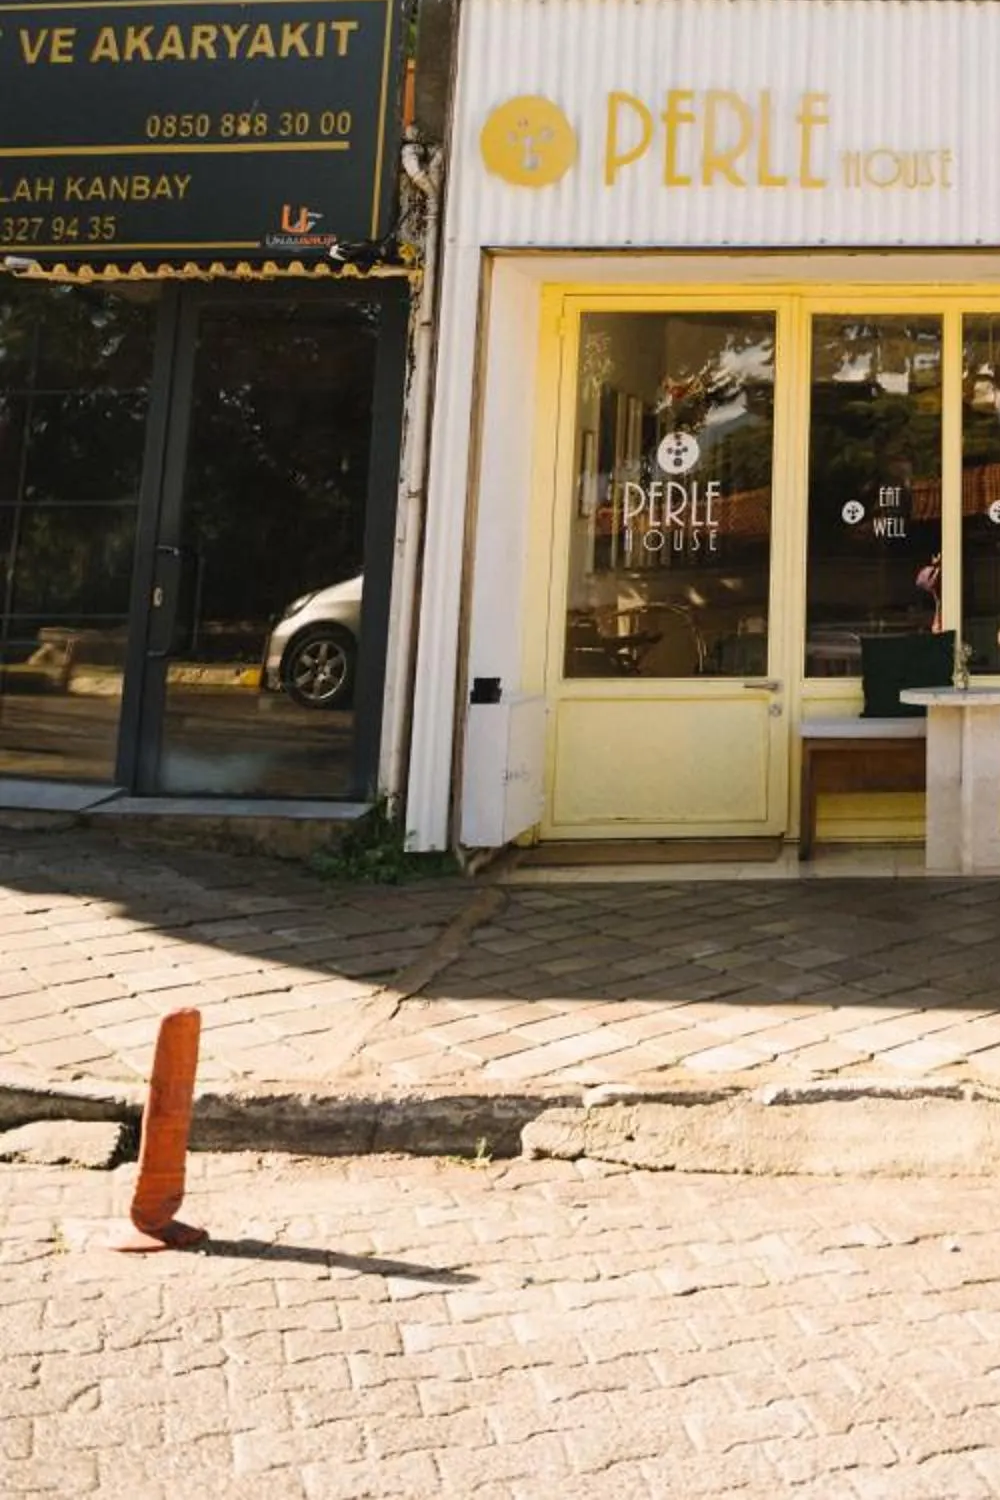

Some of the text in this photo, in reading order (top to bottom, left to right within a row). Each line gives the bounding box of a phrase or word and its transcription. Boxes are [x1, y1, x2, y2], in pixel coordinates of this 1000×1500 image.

[19, 20, 360, 64] VE AKARYAKIT
[146, 113, 210, 138] 0850
[279, 111, 310, 136] 30
[320, 111, 351, 135] 00
[603, 88, 953, 190] PERLE HOUSE
[65, 173, 192, 202] KANBAY
[2, 215, 116, 241] 327 94 35
[623, 481, 721, 527] PERLE
[879, 486, 902, 508] EAT
[623, 529, 717, 552] HOUSE
[873, 516, 907, 538] WELL
